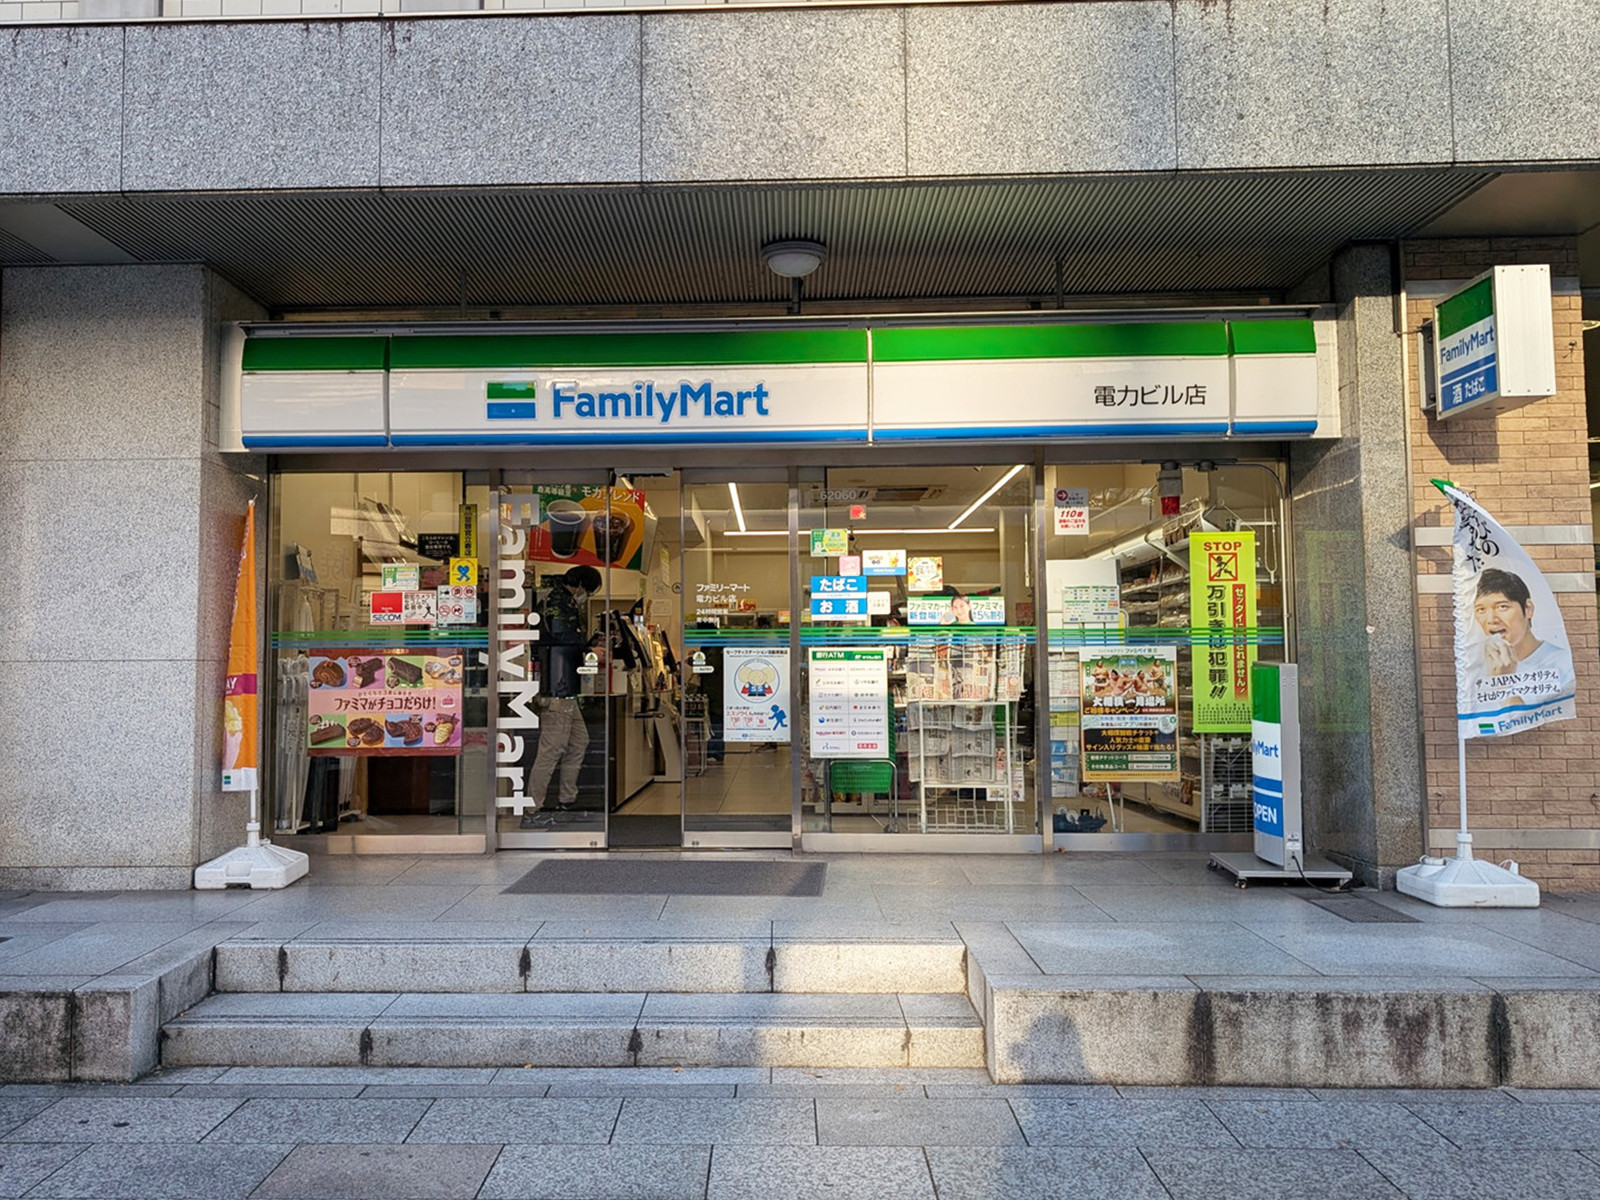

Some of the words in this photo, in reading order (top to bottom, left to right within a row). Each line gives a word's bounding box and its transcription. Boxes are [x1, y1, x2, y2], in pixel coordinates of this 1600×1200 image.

[1440, 325, 1494, 365] FamilyMart
[1094, 384, 1207, 406] 電力ビル店
[1452, 383, 1463, 404] 酒
[1465, 376, 1486, 398] たばこ
[553, 382, 769, 423] FamilyMart
[1203, 541, 1242, 552] STOP
[696, 583, 751, 592] ファミリーマート
[819, 578, 858, 592] たばこ
[696, 595, 737, 604] 電力ビル店
[909, 602, 950, 611] ファミマカード
[372, 614, 402, 622] SECOM
[480, 494, 540, 816] FamilyMart
[334, 696, 437, 711] ファミマがチョコだらけ!
[1498, 706, 1563, 732] FamilyMart
[1254, 802, 1277, 824] OPEN
